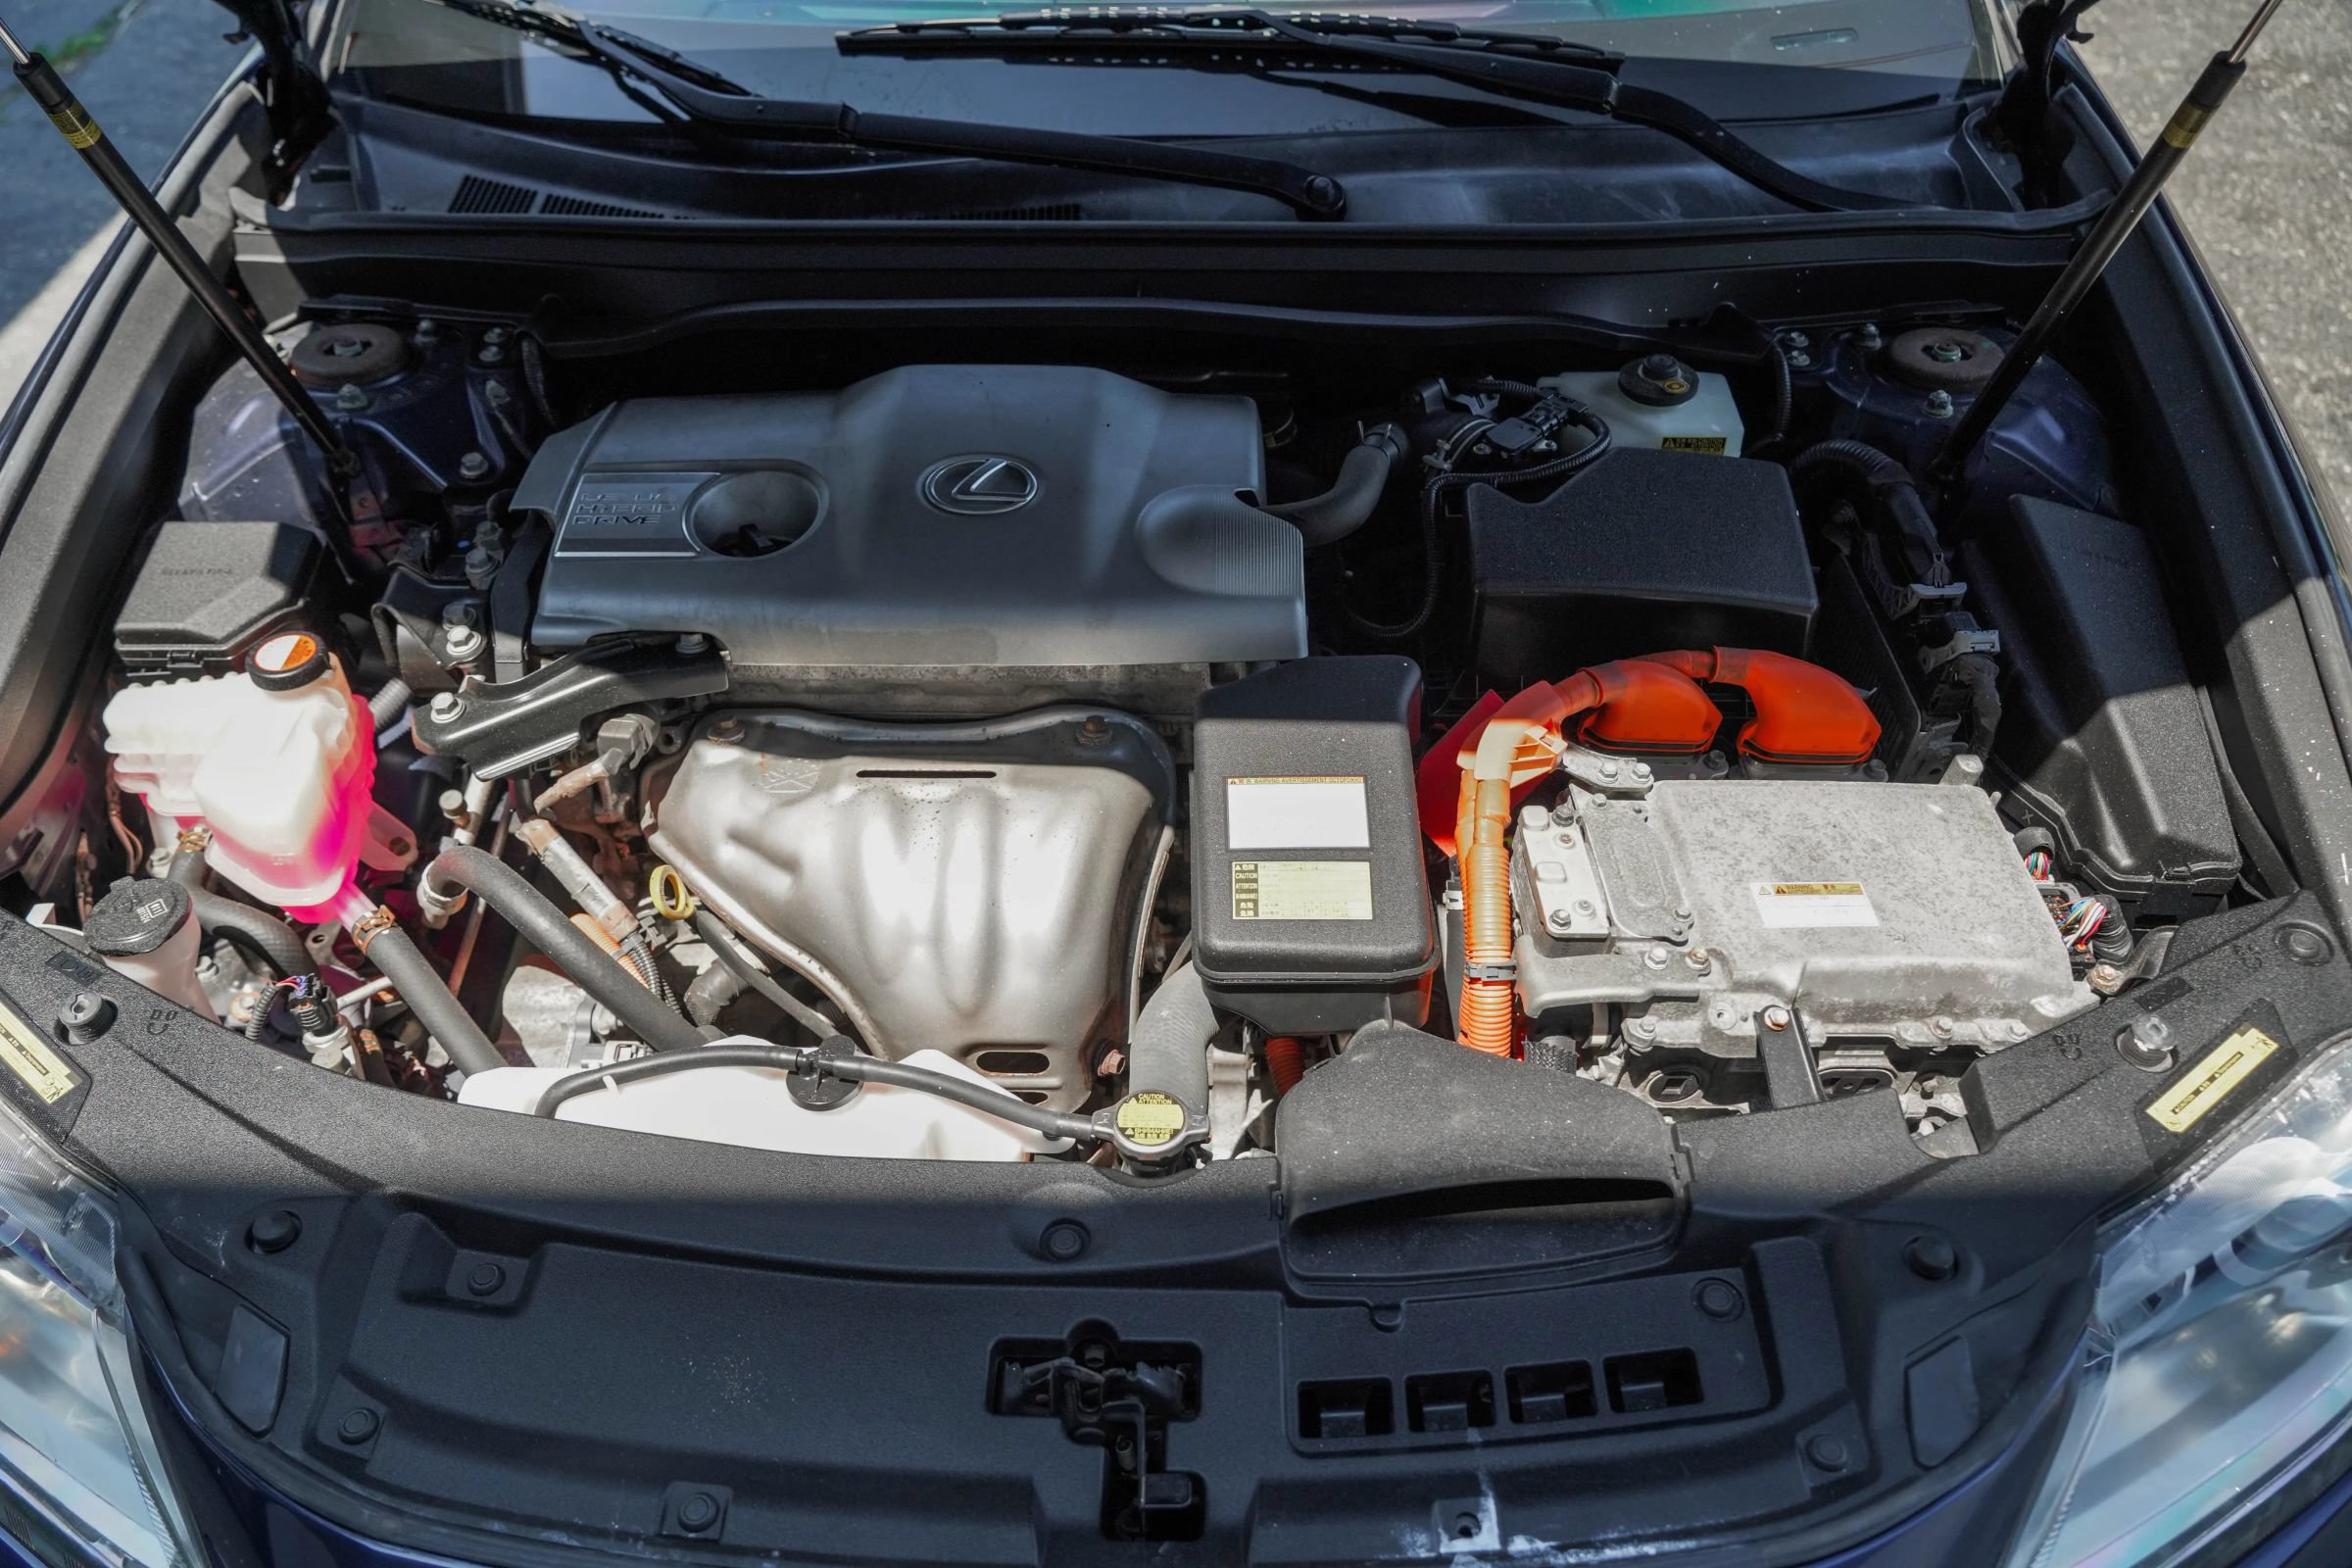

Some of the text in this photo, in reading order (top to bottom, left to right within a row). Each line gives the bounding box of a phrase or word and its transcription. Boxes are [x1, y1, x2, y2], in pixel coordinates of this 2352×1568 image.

[576, 503, 678, 514] HYBRID
[571, 514, 662, 525] DRIVE
[1281, 775, 1327, 784] AVERTISSEMENT
